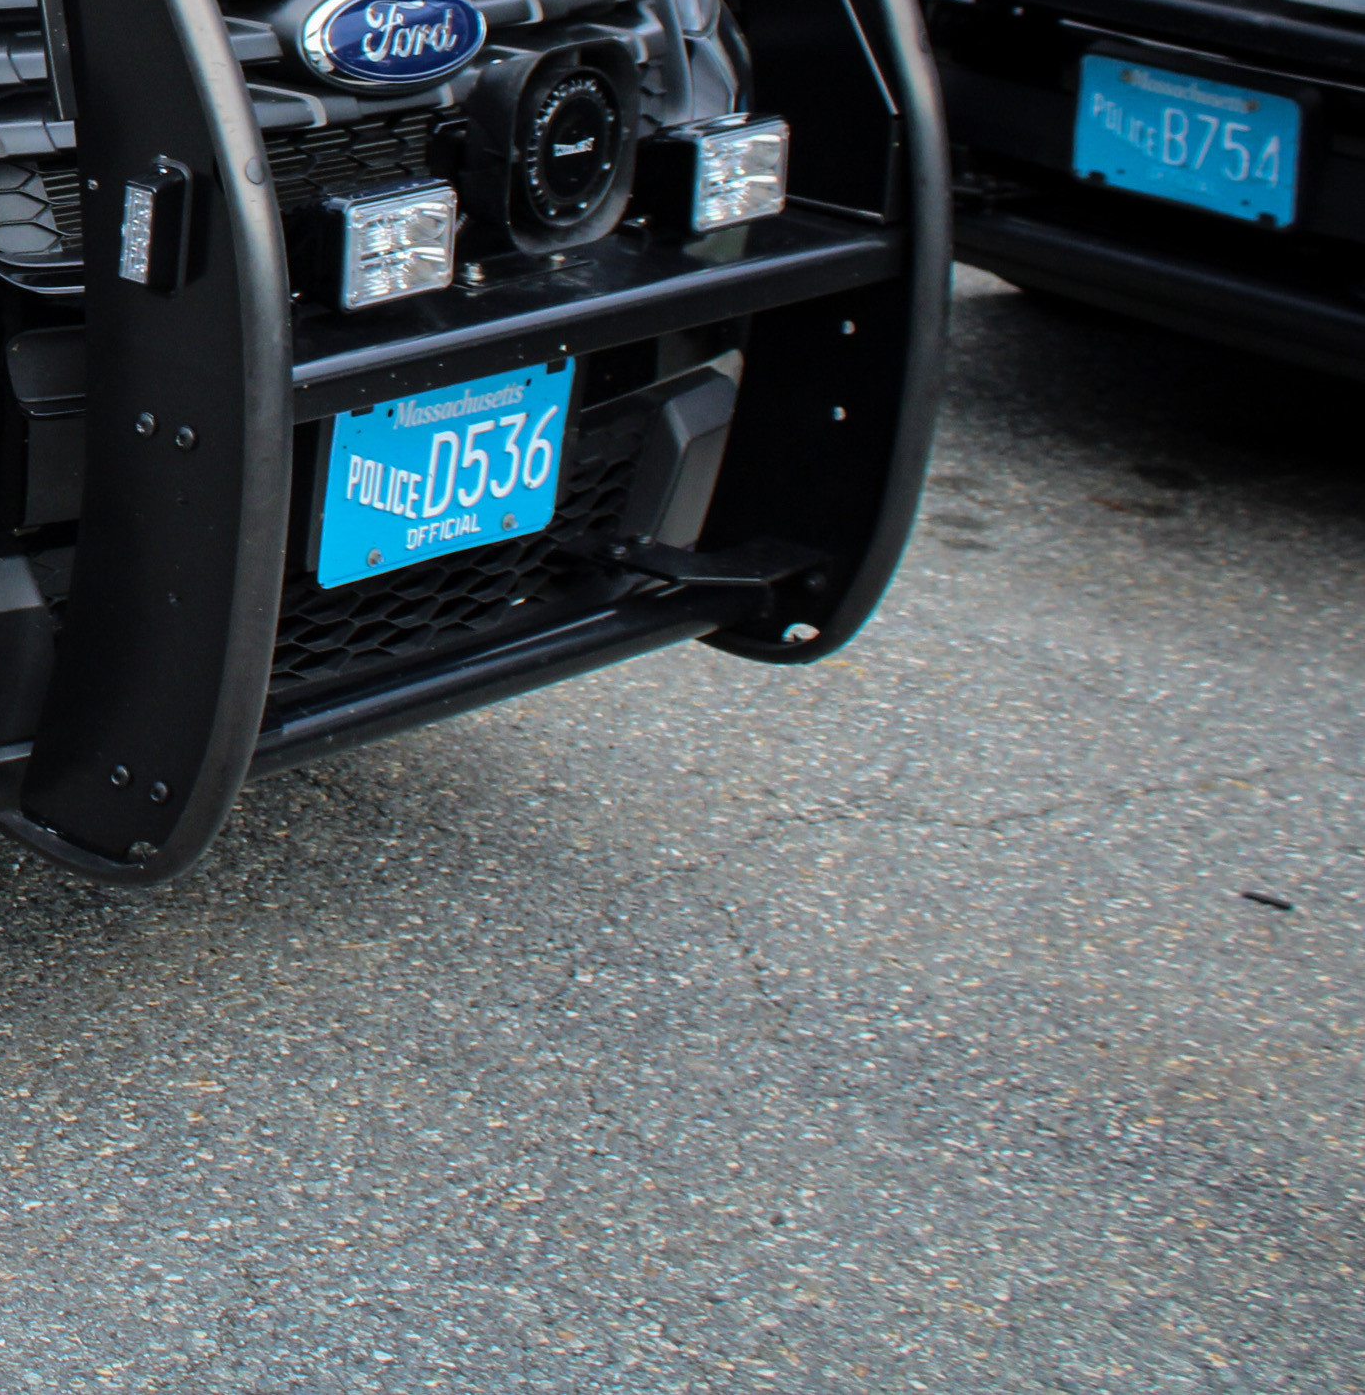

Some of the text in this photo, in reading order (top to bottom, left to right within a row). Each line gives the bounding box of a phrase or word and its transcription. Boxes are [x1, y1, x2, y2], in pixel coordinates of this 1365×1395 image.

[1092, 92, 1157, 157] POLICE
[1162, 107, 1280, 188] B754
[393, 383, 525, 430] Massachusetts
[347, 404, 559, 520] POLICE D536
[405, 513, 481, 550] OFFICIAL
